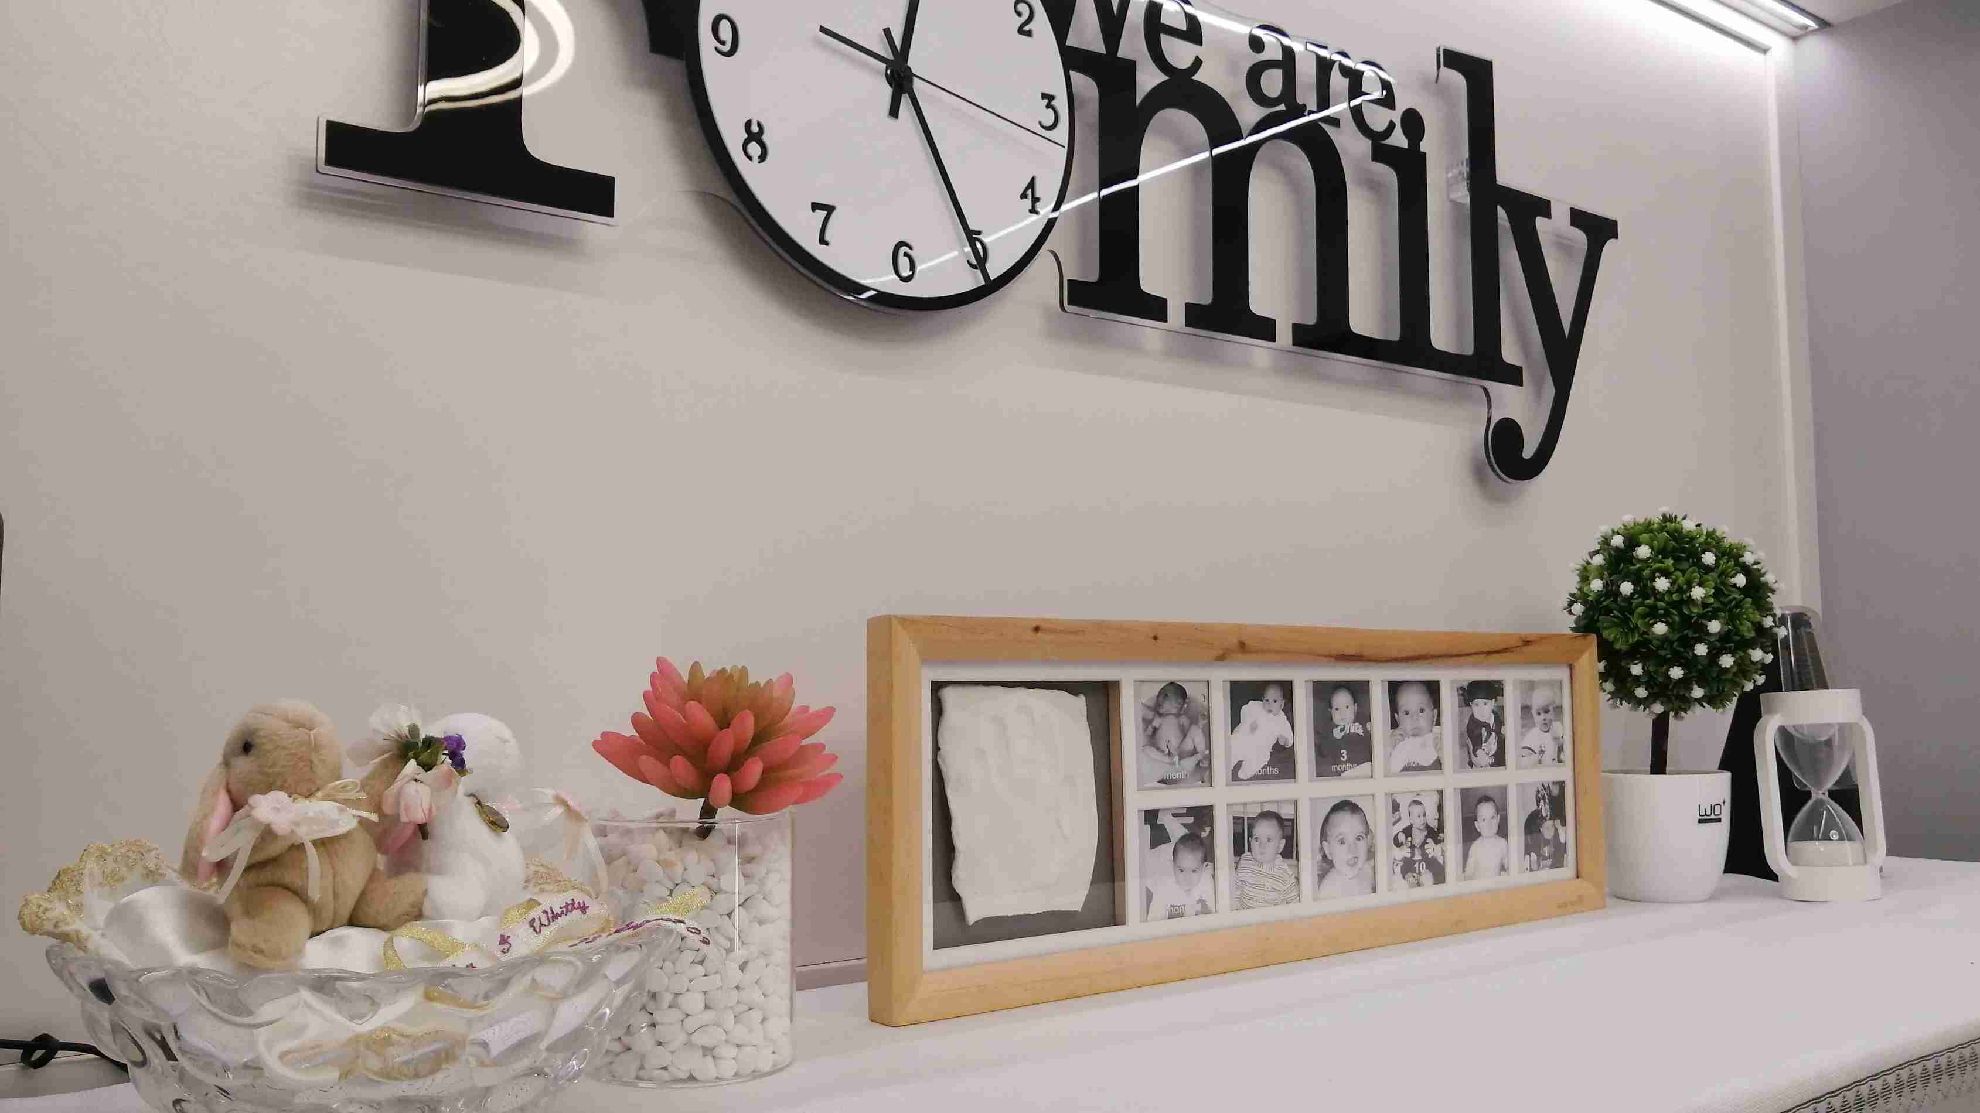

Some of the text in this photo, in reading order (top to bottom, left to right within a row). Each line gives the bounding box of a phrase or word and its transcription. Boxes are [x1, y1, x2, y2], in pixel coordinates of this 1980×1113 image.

[711, 13, 739, 57] 9
[1014, 0, 1034, 37] 2
[1039, 92, 1059, 131] 3
[742, 118, 768, 163] 8
[1020, 176, 1042, 215] 4
[811, 202, 836, 246] 7
[892, 241, 915, 282] 6
[966, 230, 988, 270] 5
[1340, 749, 1348, 761] 3
[1414, 861, 1426, 874] 10
